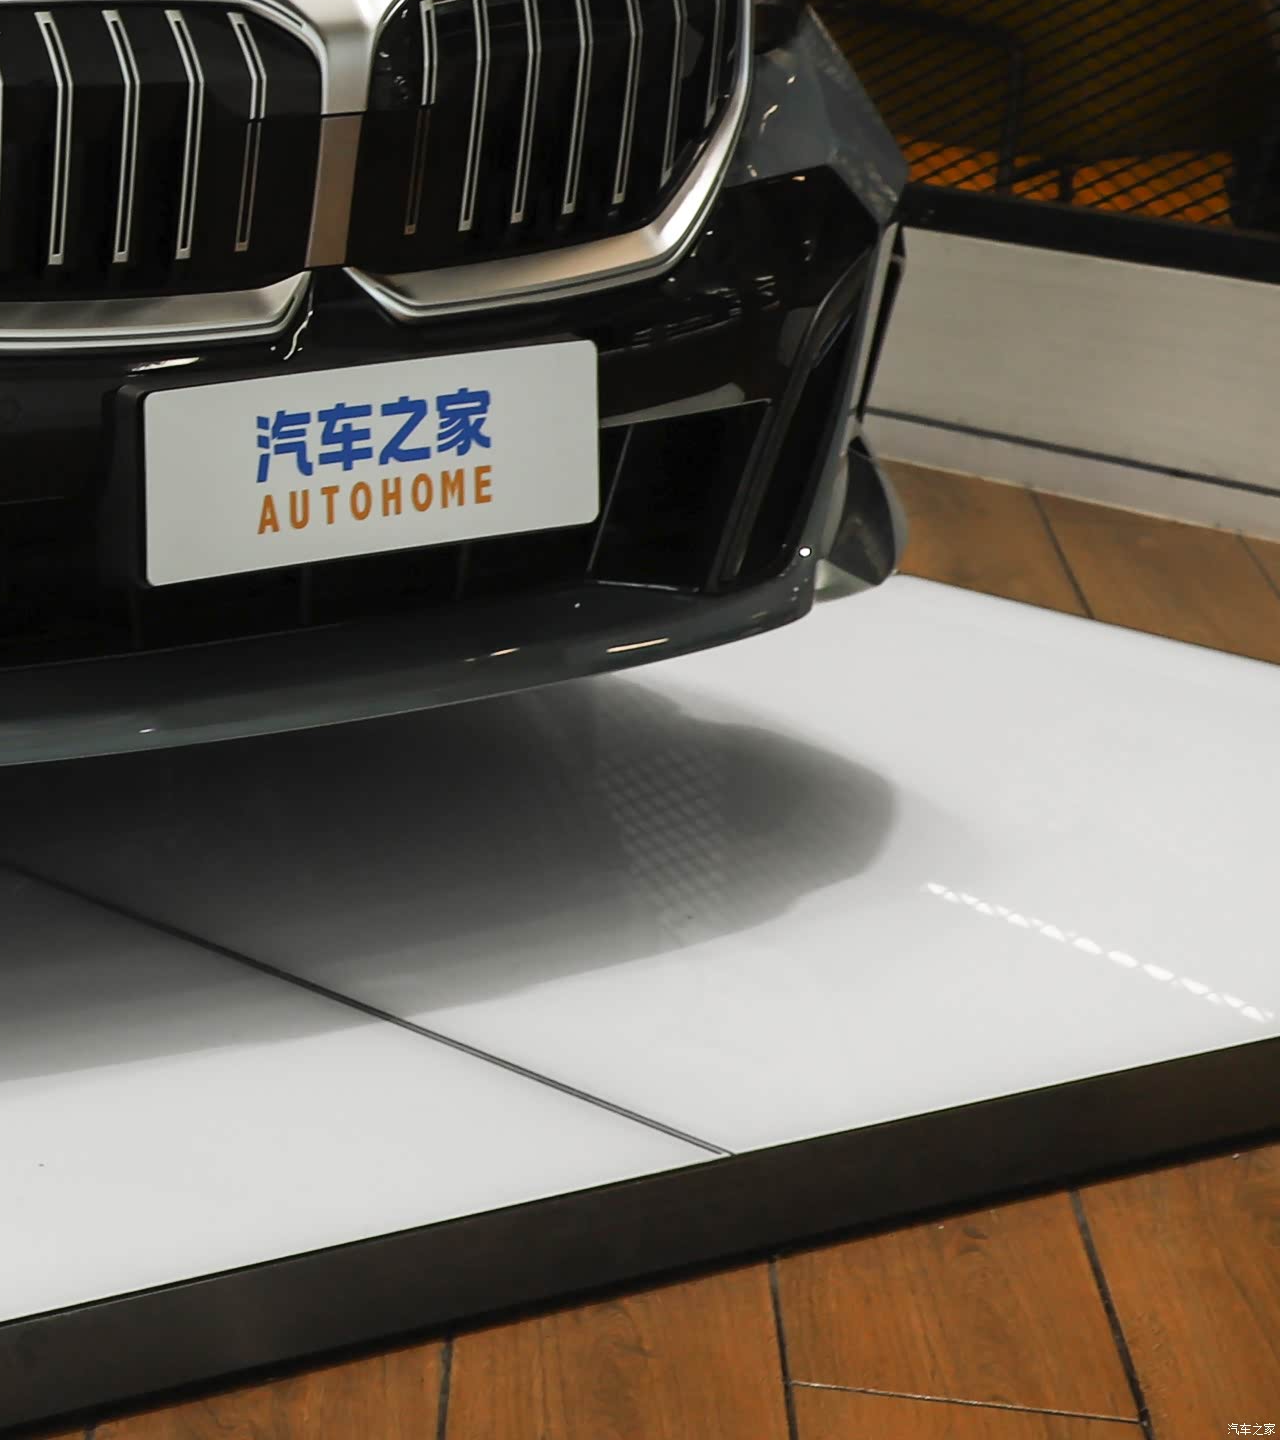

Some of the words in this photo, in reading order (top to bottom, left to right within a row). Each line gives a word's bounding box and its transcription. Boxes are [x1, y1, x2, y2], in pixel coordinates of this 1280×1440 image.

[256, 388, 492, 483] 汽车之家
[257, 465, 493, 534] AUTOHOME
